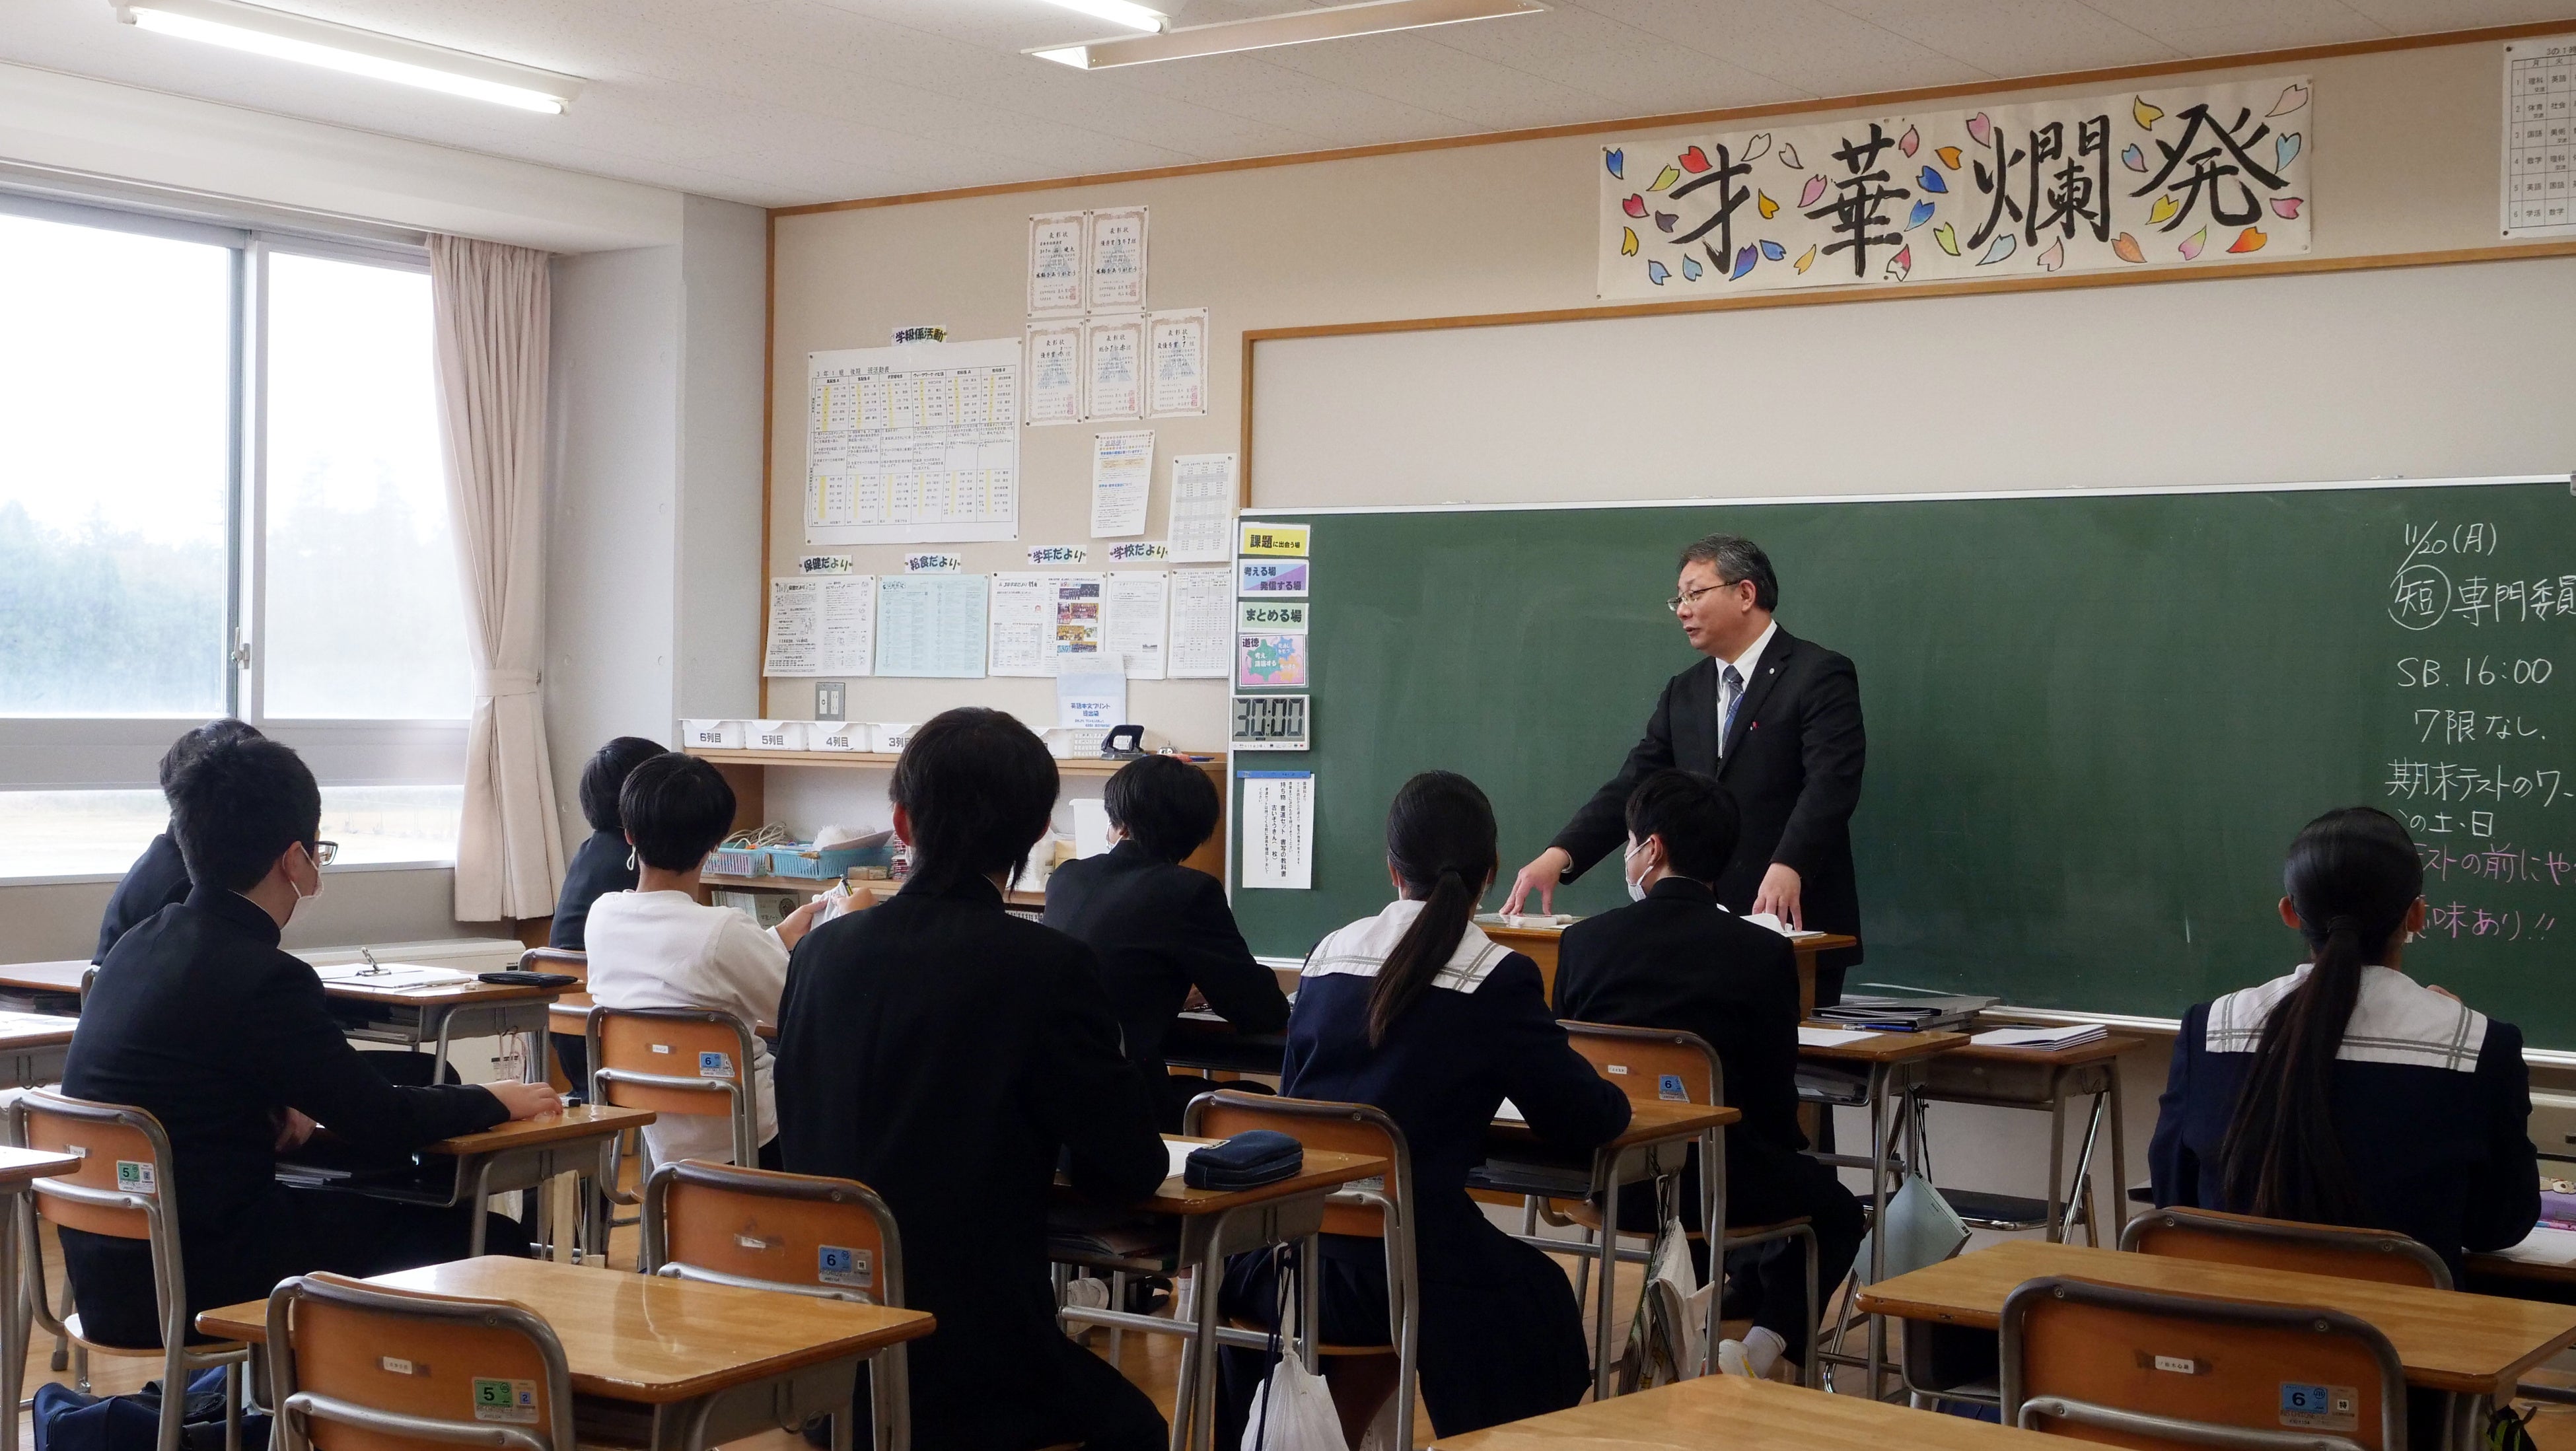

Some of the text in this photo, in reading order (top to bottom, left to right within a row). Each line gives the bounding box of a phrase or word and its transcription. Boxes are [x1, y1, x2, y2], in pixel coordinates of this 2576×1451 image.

[2552, 75, 2566, 83] 英語
[2551, 127, 2565, 136] 美術
[1096, 266, 1137, 275] 感動をありがとう
[896, 328, 944, 343] 学級係活動
[1113, 543, 1166, 559] 学校だより
[2396, 520, 2497, 574] 11/20 (月)
[1033, 547, 1083, 563] 学年だより
[804, 557, 848, 573] 保健だより
[910, 555, 957, 571] 給食だより
[1244, 567, 1277, 577] 考える場
[1260, 581, 1302, 591] 発信する場
[1246, 608, 1302, 622] まとめる場
[1242, 638, 1260, 648] 道徳
[2466, 655, 2552, 685] 16:00
[1234, 698, 1304, 736] 30:00
[700, 732, 721, 743] 6列目
[762, 735, 784, 746] 5列目
[826, 736, 849, 748] 4列目
[123, 1168, 129, 1177] 5
[827, 1254, 836, 1266] 6
[483, 1387, 495, 1401] 5
[2292, 1392, 2306, 1406] 6
